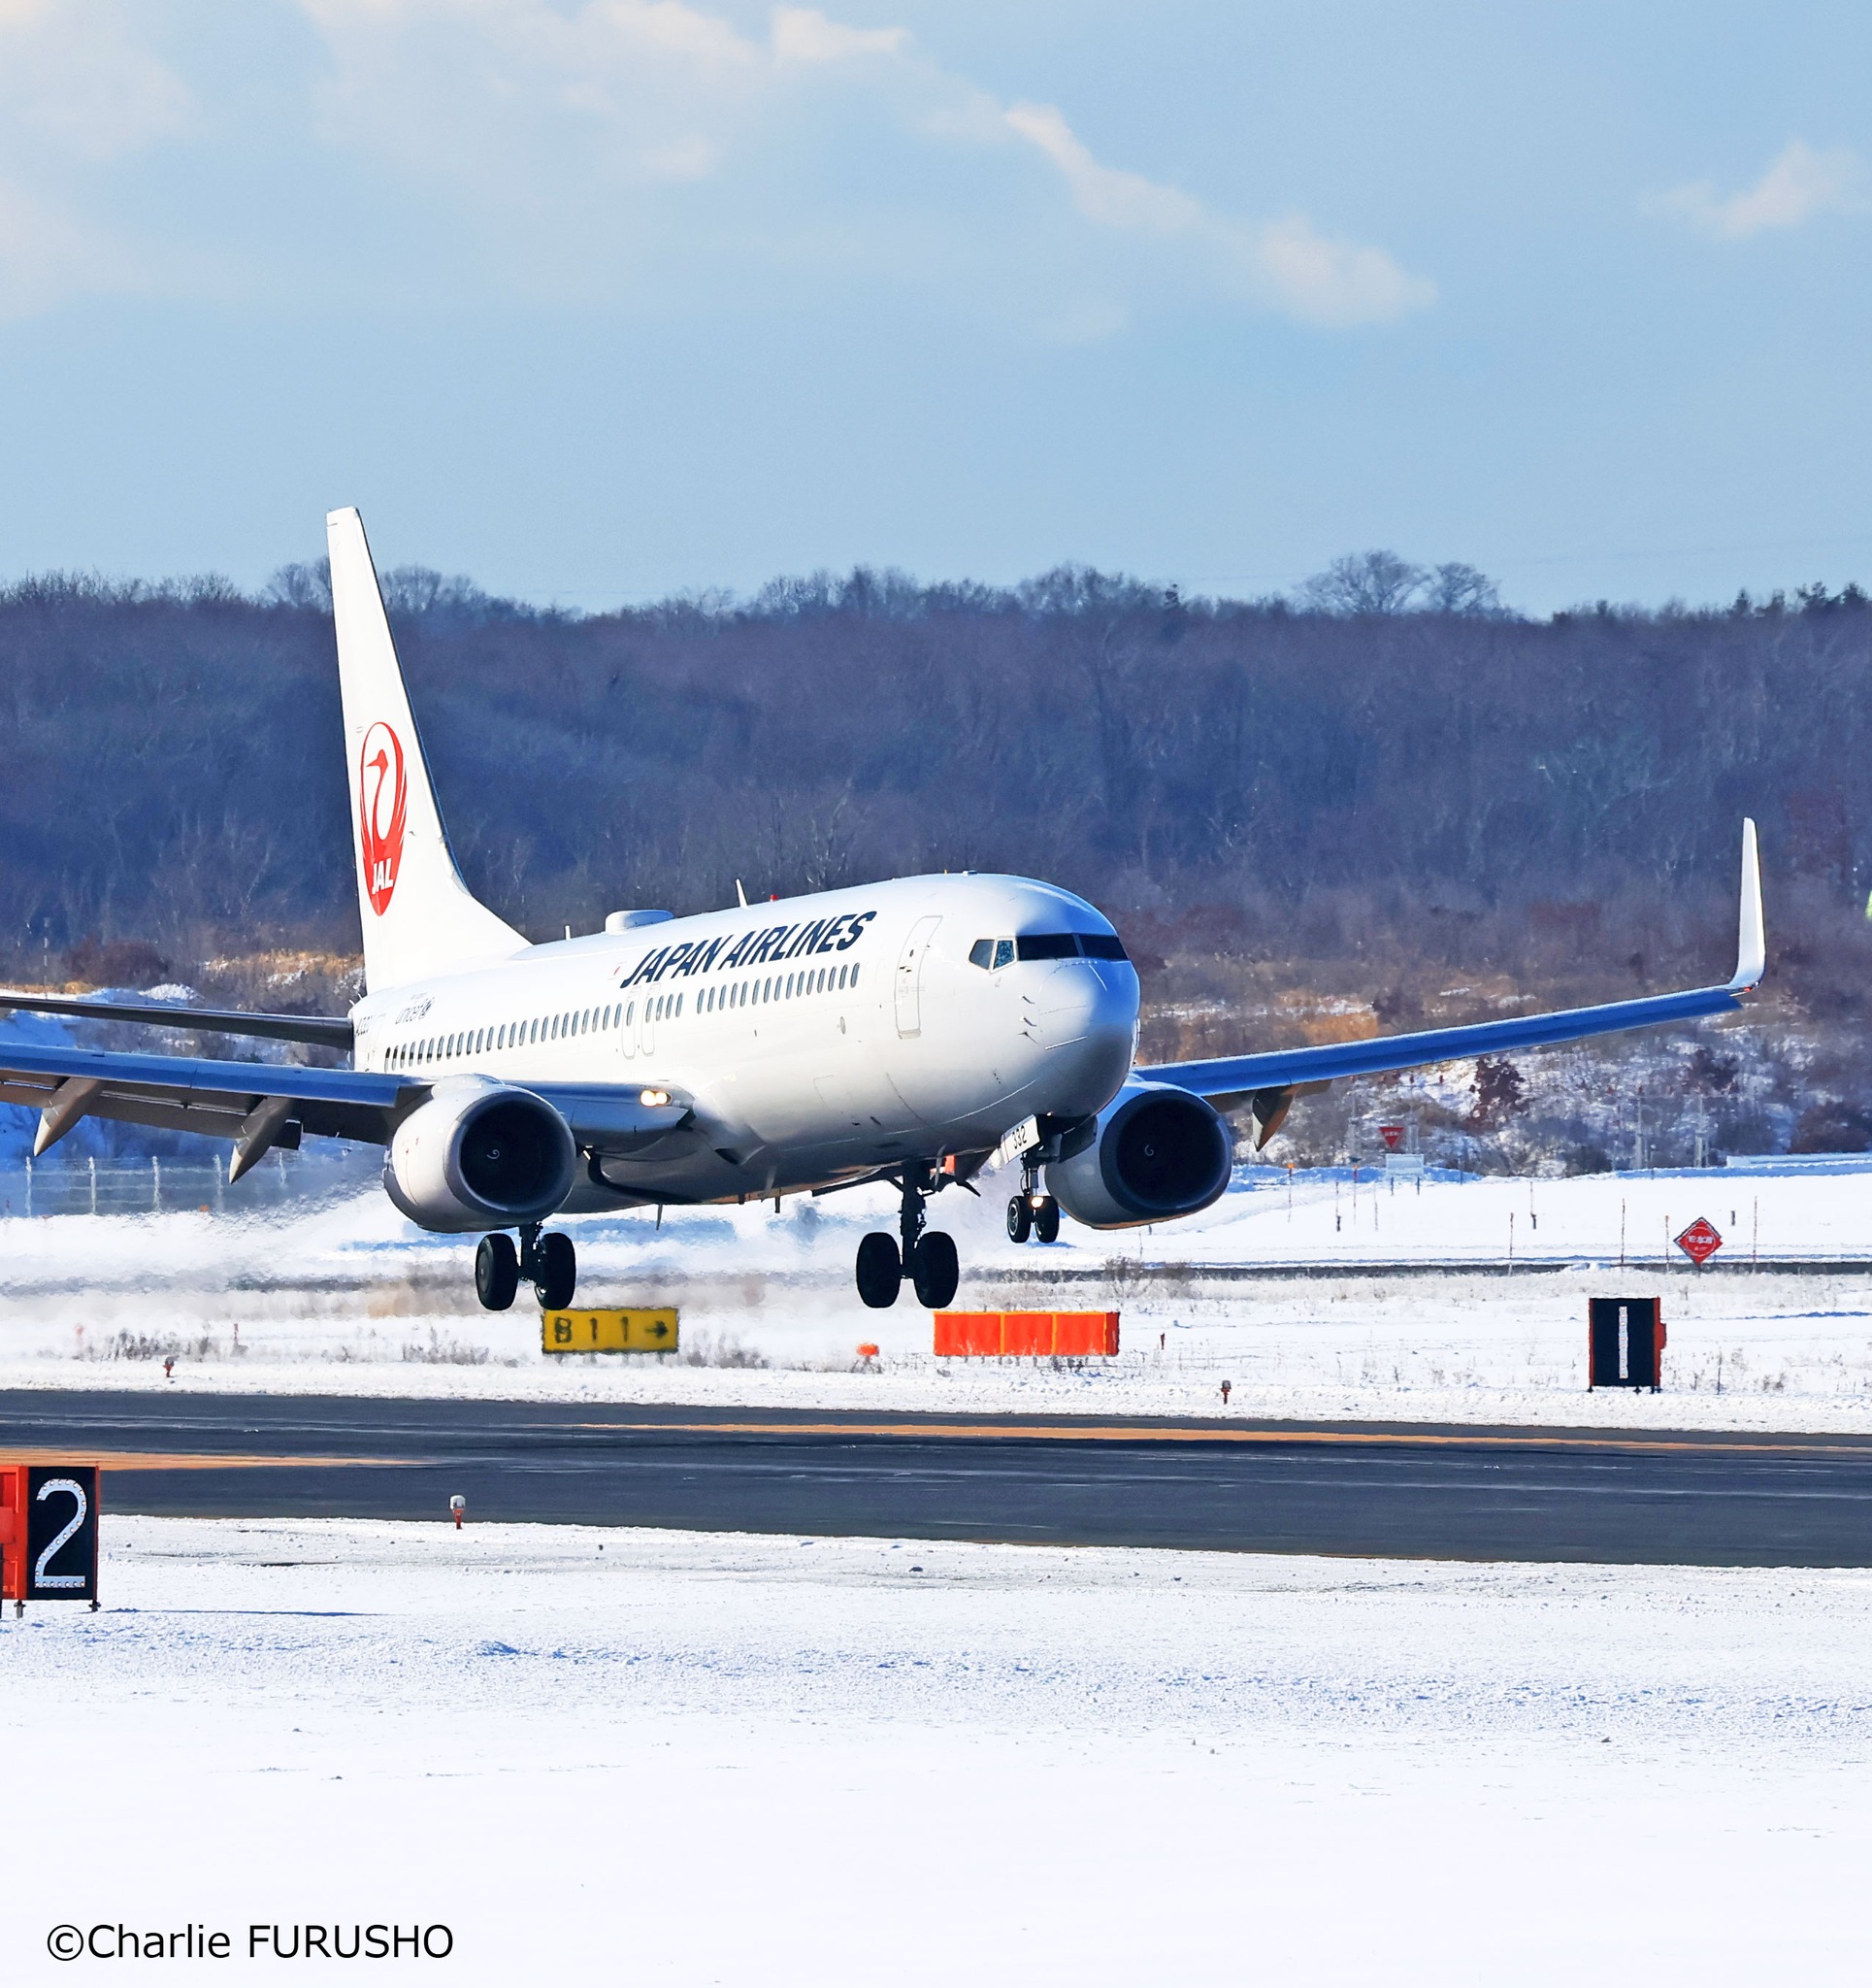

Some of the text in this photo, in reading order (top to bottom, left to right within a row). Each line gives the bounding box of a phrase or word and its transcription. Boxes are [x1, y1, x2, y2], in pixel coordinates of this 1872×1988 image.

[372, 858, 394, 895] JAL
[620, 911, 877, 988] JAPAN AIRLINES
[1012, 1125, 1027, 1149] 332
[35, 1478, 87, 1588] 2
